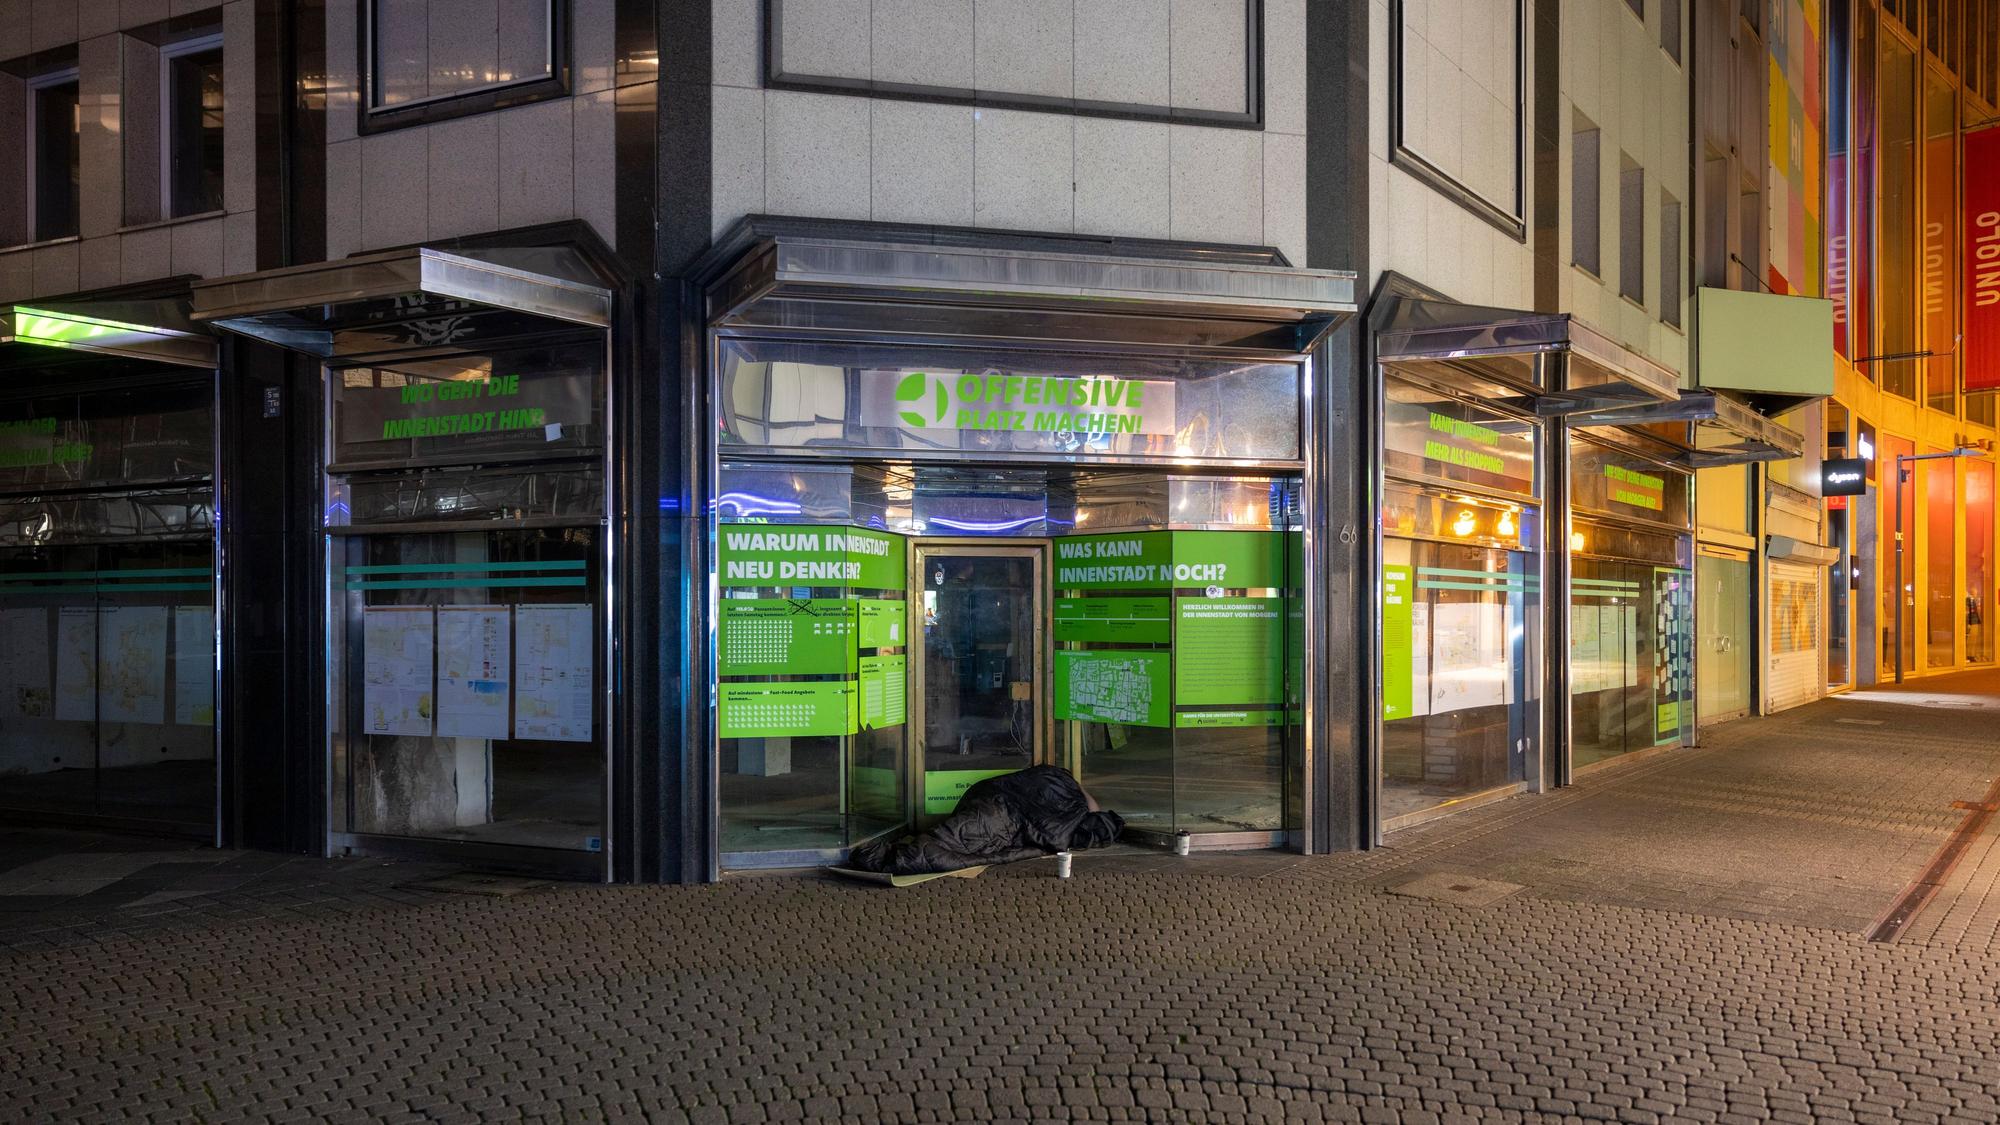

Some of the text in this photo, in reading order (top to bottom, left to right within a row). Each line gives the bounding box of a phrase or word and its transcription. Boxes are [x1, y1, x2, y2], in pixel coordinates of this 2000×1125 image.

[1790, 118, 1801, 172] HI
[1976, 211, 2000, 306] UNIQLO
[400, 374, 520, 405] WO GEHT DIE
[956, 374, 1144, 407] OFFENSIVE
[383, 412, 496, 440] INNENSTADT
[499, 408, 544, 429] HIN?
[956, 410, 1142, 434] PLATZ MACHEN!
[1430, 412, 1454, 434] KANN
[1426, 440, 1449, 462] MEHR
[1450, 446, 1464, 466] ALS
[1828, 472, 1860, 484] dyson
[726, 533, 890, 556] WARUM INNENSTADT
[1340, 524, 1357, 544] 66
[1060, 540, 1142, 559] WAS KANN
[728, 560, 861, 580] NEU DENKEN?
[1060, 563, 1226, 584] INNENSTADT NOCH?
